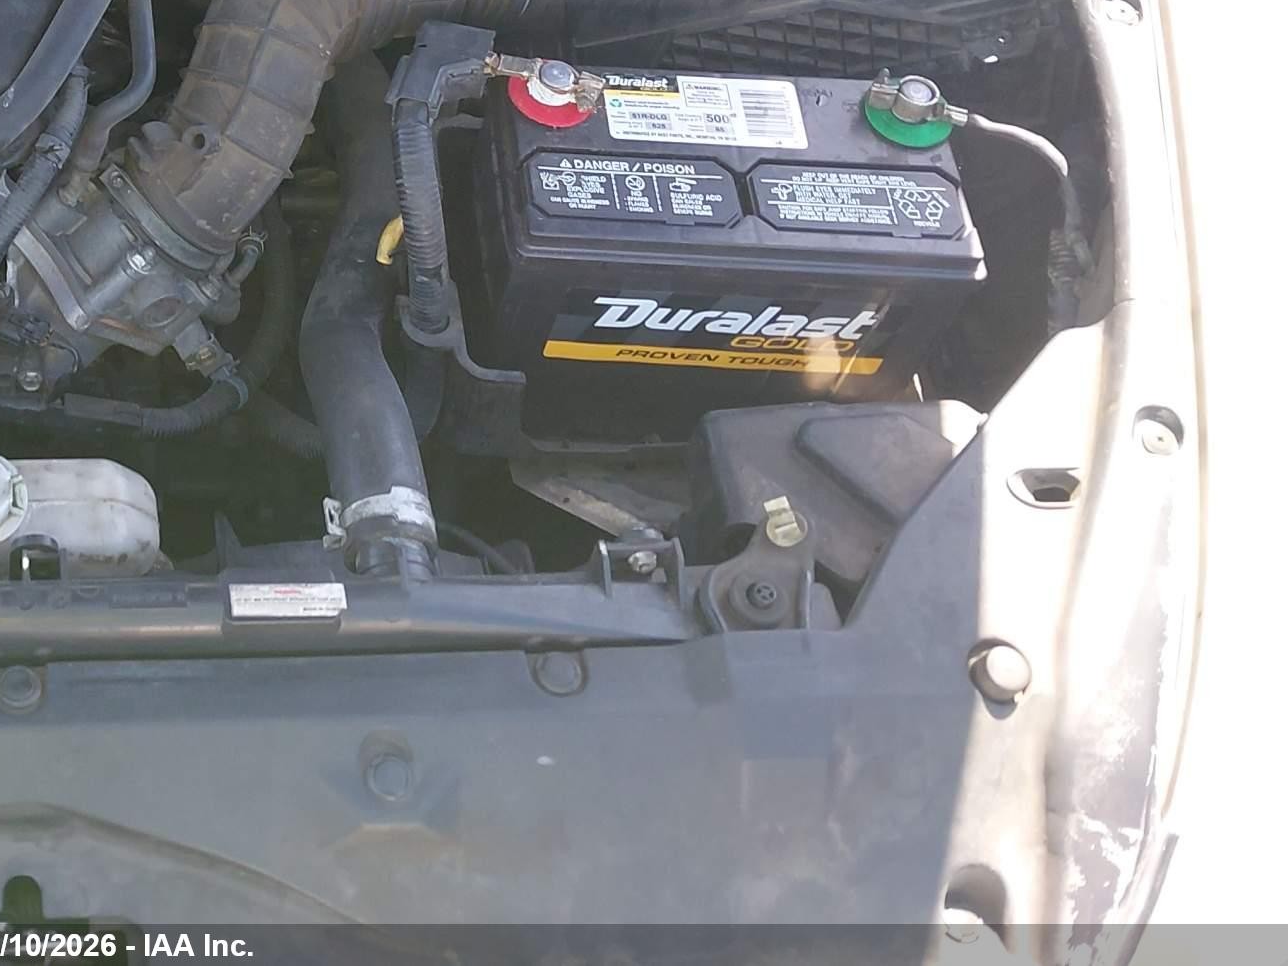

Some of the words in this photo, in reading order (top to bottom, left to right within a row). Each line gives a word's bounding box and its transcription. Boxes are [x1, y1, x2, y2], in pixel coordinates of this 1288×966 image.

[605, 75, 669, 89] Duralast
[705, 113, 730, 124] 500
[574, 159, 629, 172] DANGER
[643, 162, 695, 175] POISON
[593, 296, 880, 340] Duralast
[731, 337, 854, 352] GOLD
[615, 349, 721, 363] PROVEN
[728, 355, 812, 368] TOUGH
